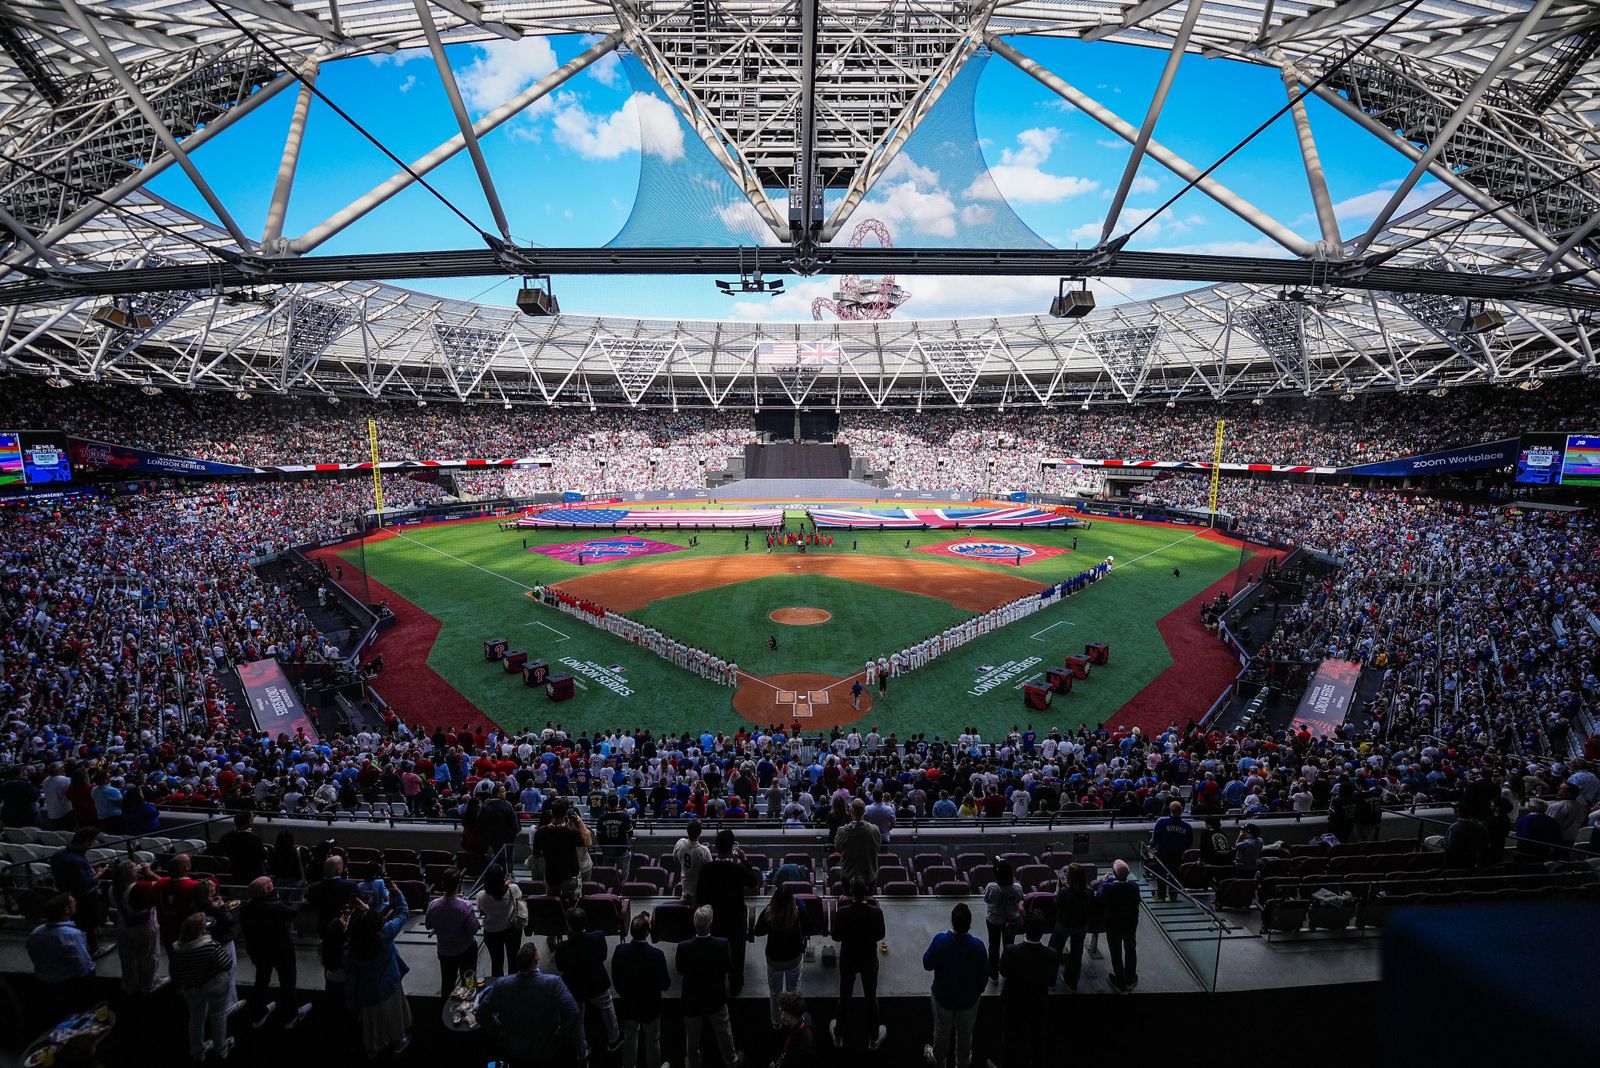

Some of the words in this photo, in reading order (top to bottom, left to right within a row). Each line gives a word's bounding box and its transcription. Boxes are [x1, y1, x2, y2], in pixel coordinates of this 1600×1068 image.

[147, 459, 180, 468] LONDON
[180, 463, 206, 471] SERIES
[1412, 458, 1446, 468] zoom
[1448, 453, 1504, 464] Workplace
[558, 656, 602, 679] LONDON
[595, 674, 635, 697] SERIES
[968, 671, 1016, 697] LONDON
[1008, 656, 1042, 674] SERIES
